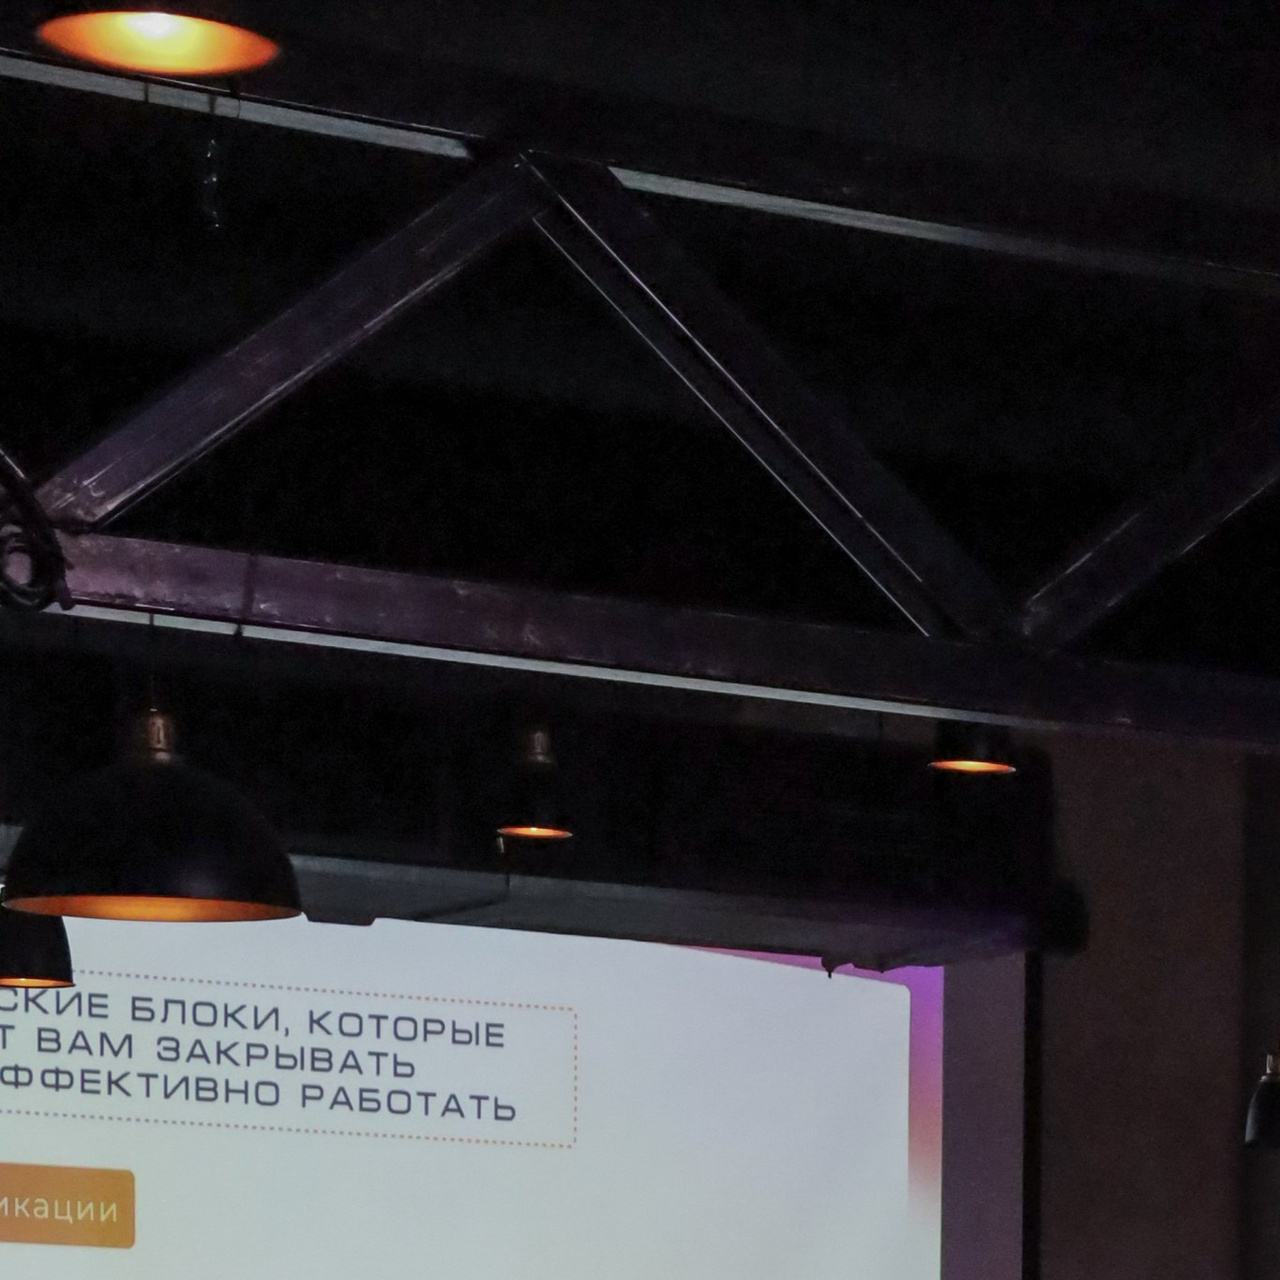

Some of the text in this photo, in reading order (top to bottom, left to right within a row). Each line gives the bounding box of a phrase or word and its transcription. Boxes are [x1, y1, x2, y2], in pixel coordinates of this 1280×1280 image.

[130, 995, 290, 1038] БЛОКИ,
[308, 1008, 505, 1049] КОТОРЫЕ
[36, 1026, 134, 1060] ВАМ
[155, 1035, 416, 1079] ЗАКРЫВАТЬ
[0, 1062, 517, 1123] ФФЕКТИВНО РАБОТАТЬ
